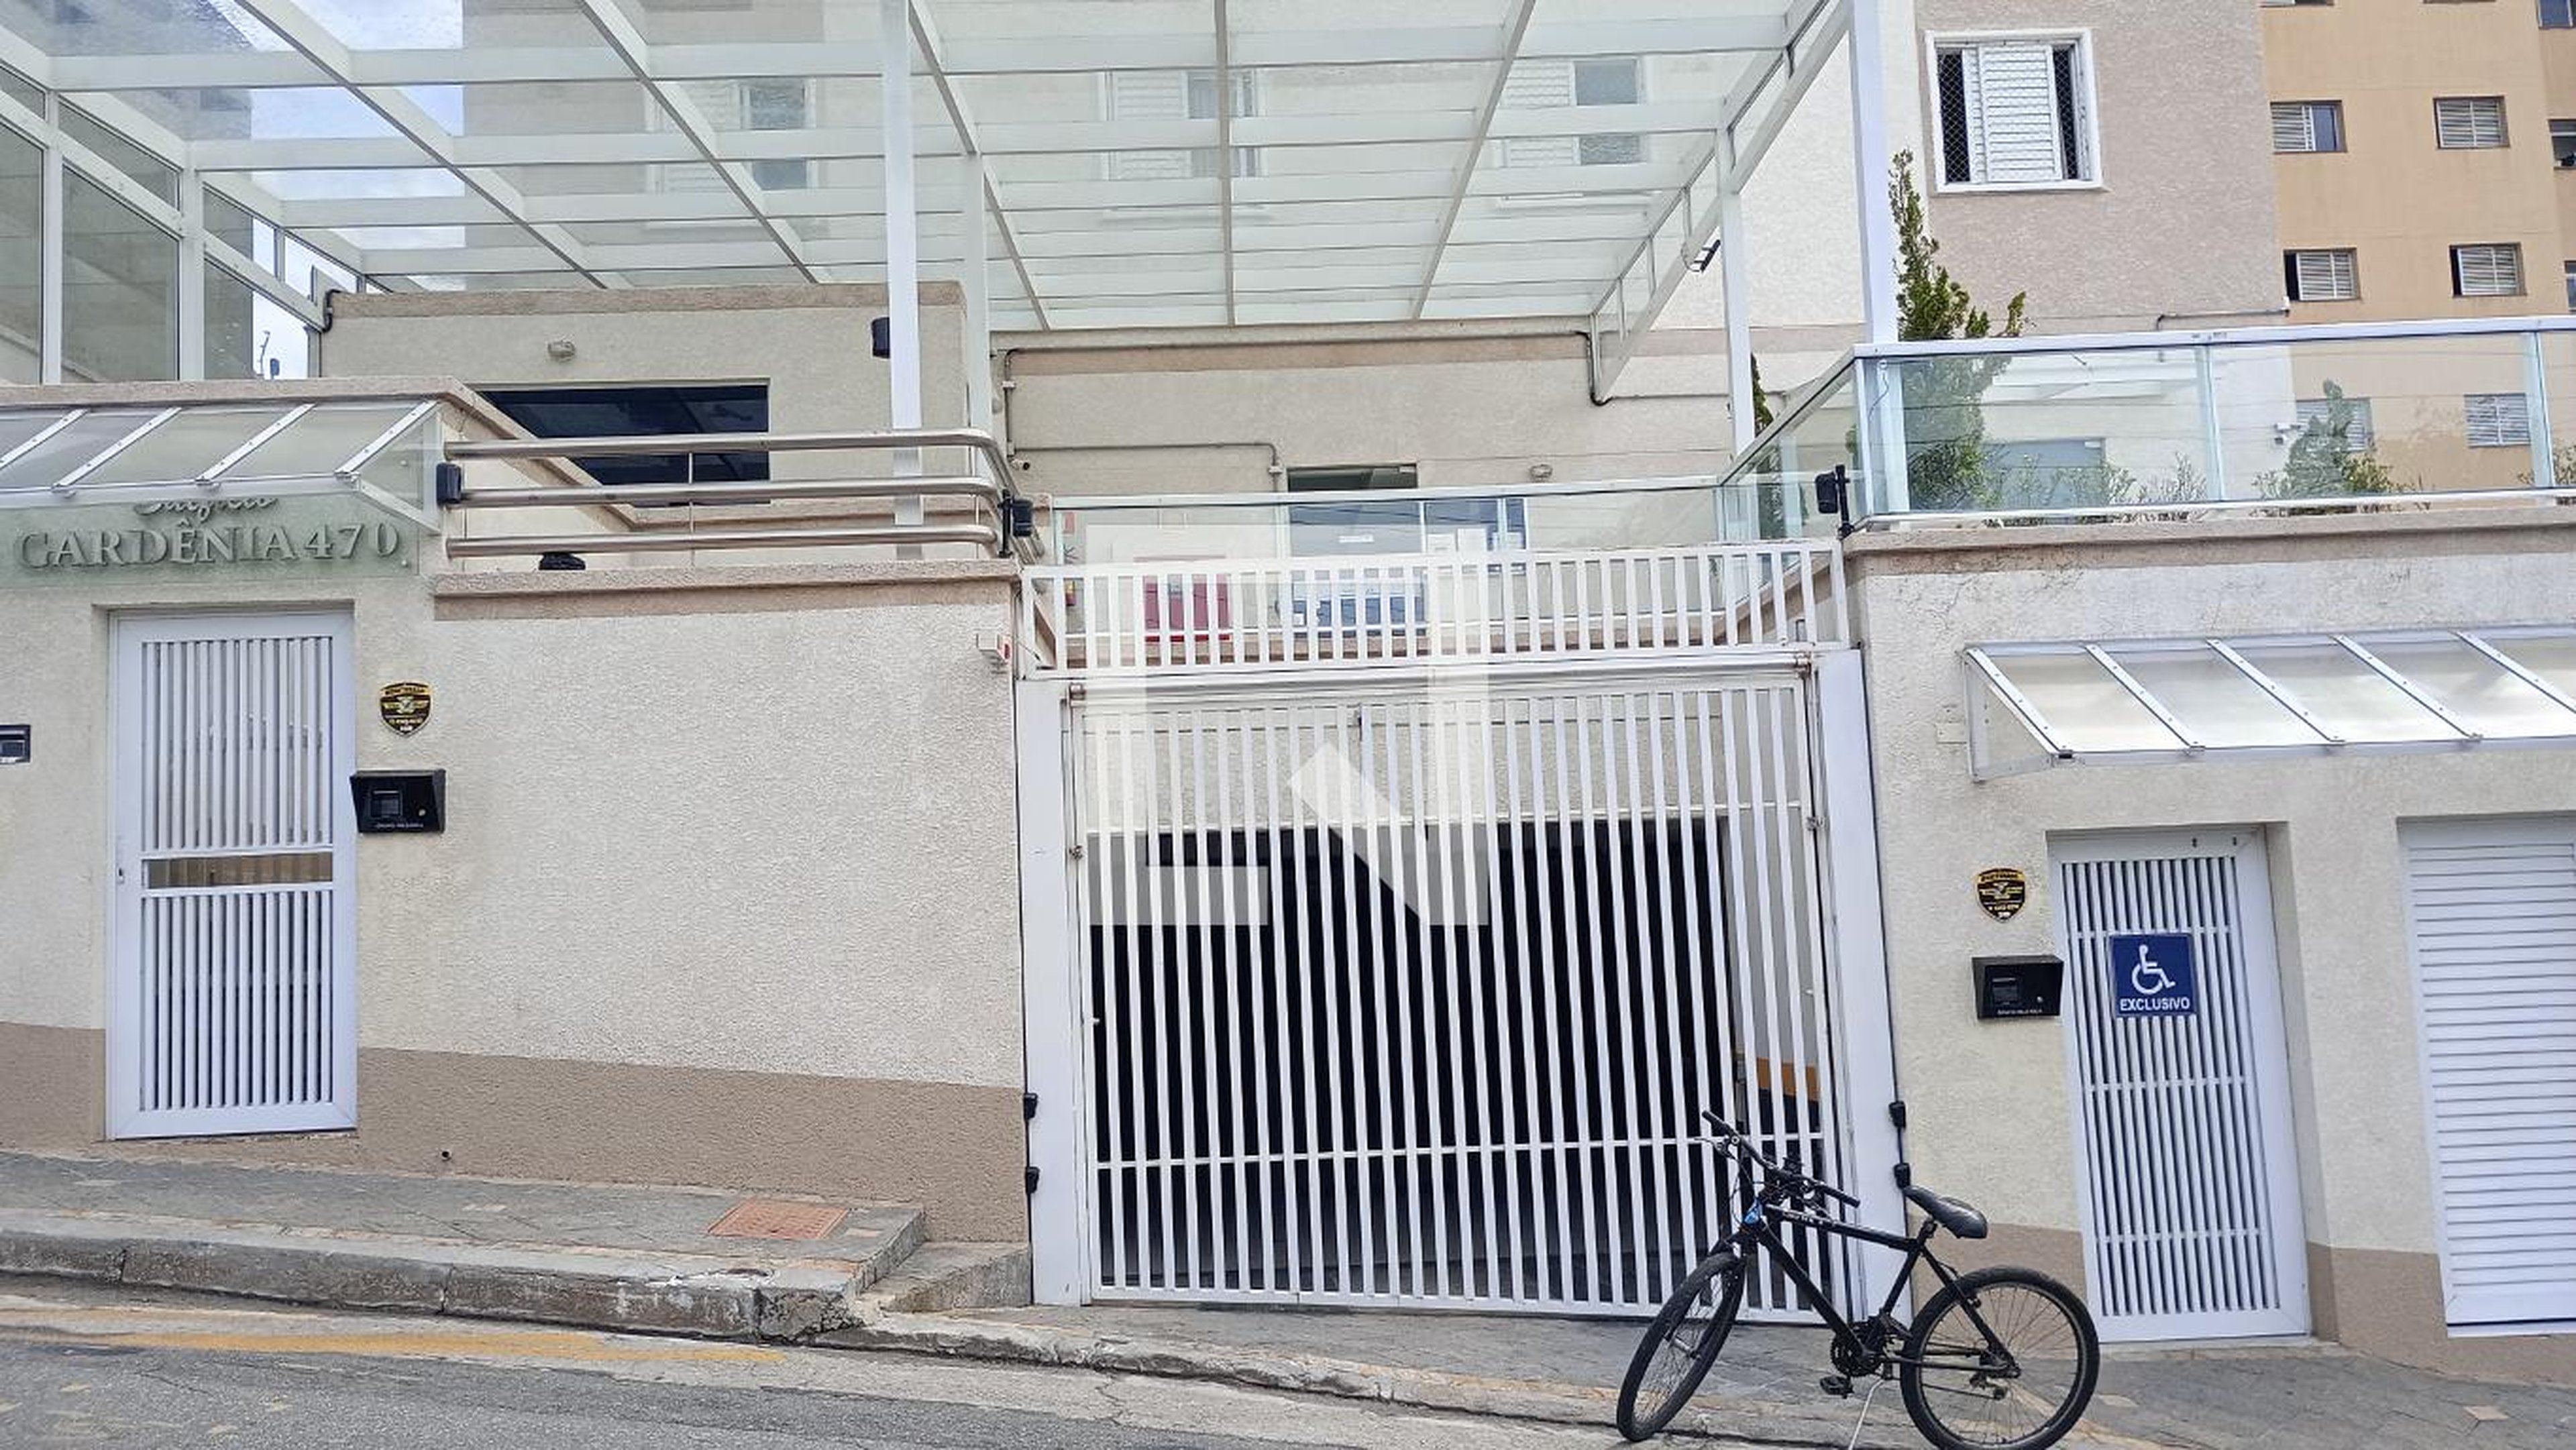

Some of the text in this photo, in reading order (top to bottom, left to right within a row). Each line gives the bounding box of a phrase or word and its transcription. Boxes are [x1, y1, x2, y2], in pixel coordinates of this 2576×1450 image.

[21, 519, 400, 568] GARDÊNIA 470
[2120, 997, 2191, 1011] EXCLUSIVO
